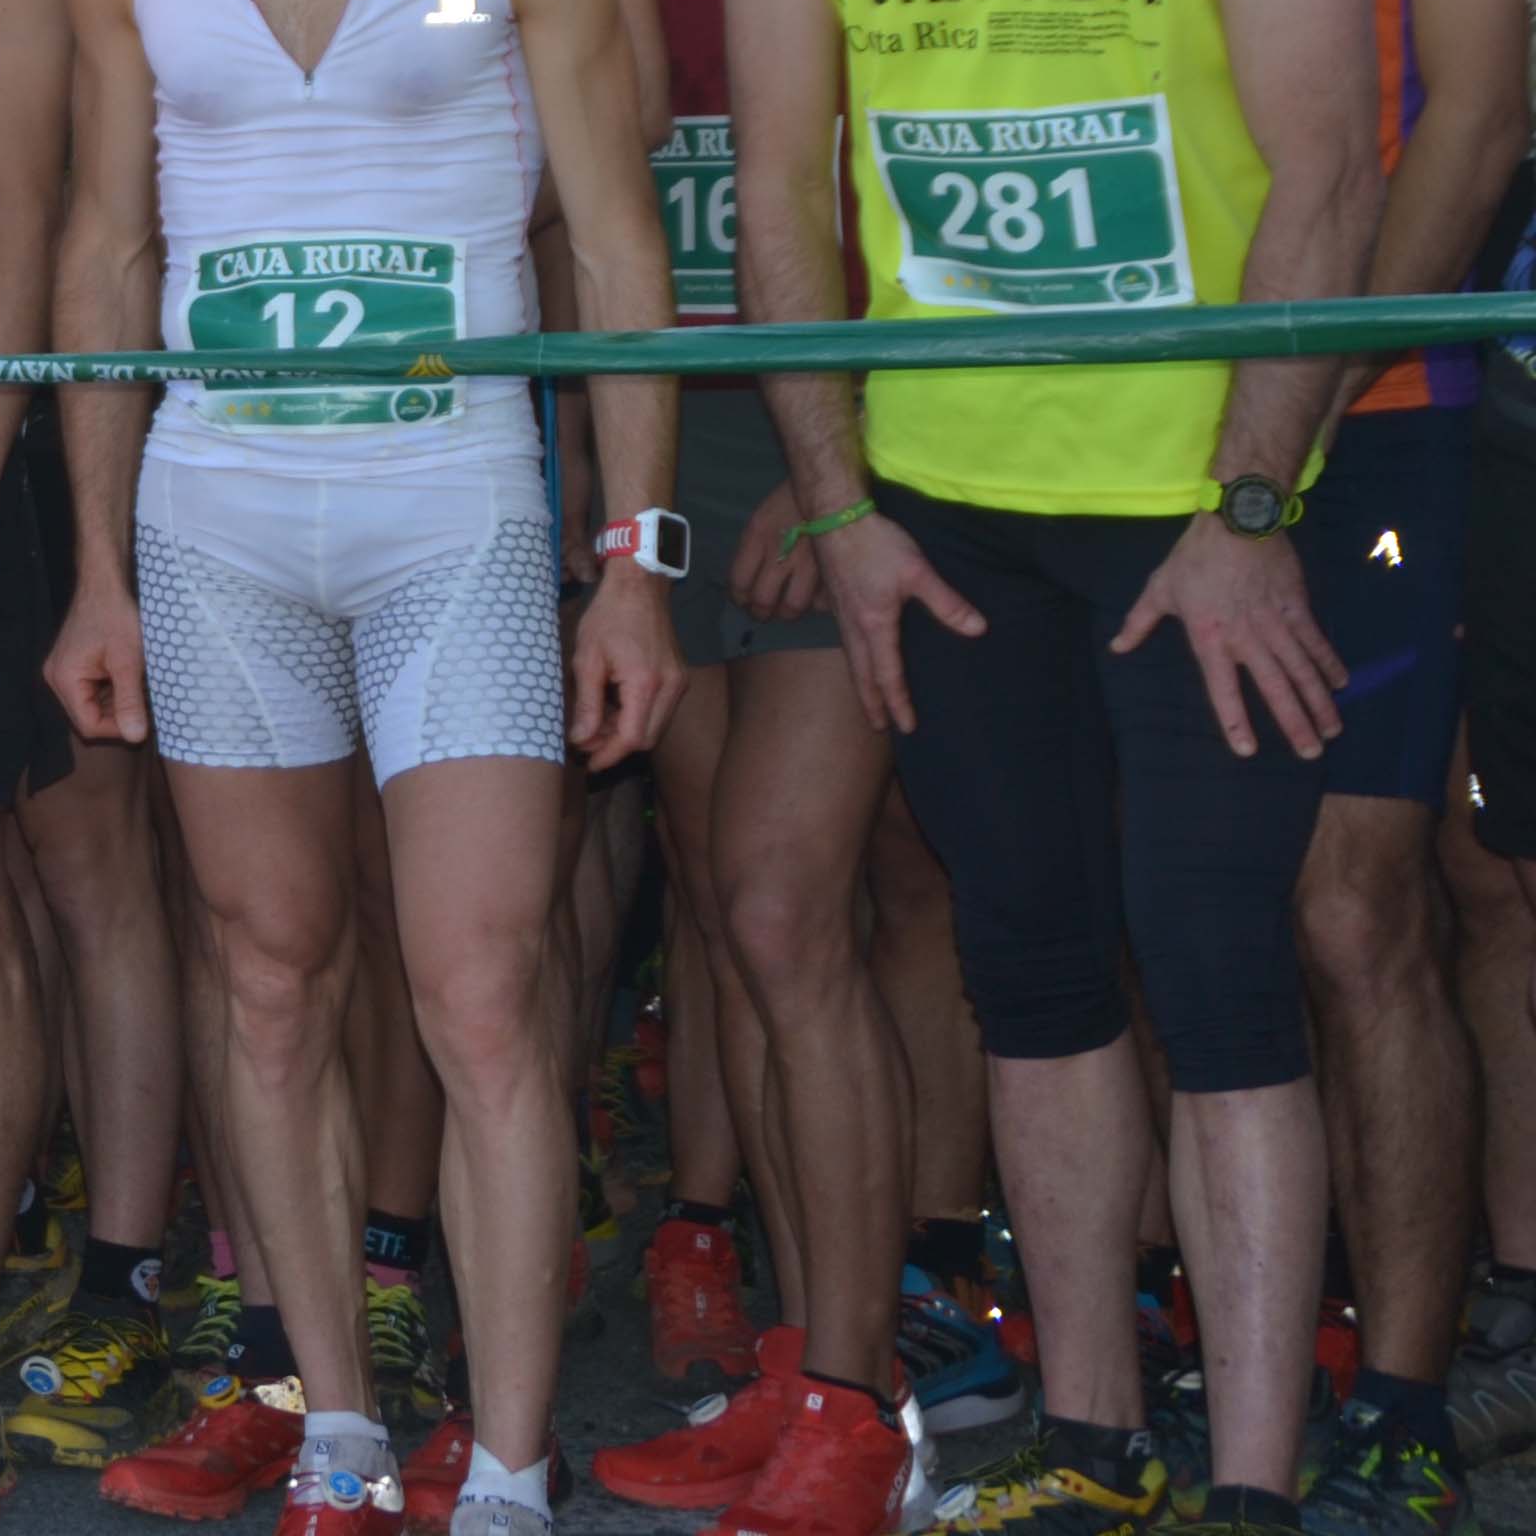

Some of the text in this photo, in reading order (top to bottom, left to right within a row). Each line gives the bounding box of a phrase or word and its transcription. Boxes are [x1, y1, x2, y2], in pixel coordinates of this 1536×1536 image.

[912, 19, 978, 51] Rica
[893, 111, 1135, 154] CAJA RURAL
[667, 175, 737, 253] 16
[930, 167, 1098, 253] 281
[215, 243, 437, 283] CAJA RURAL
[262, 289, 365, 349] 12
